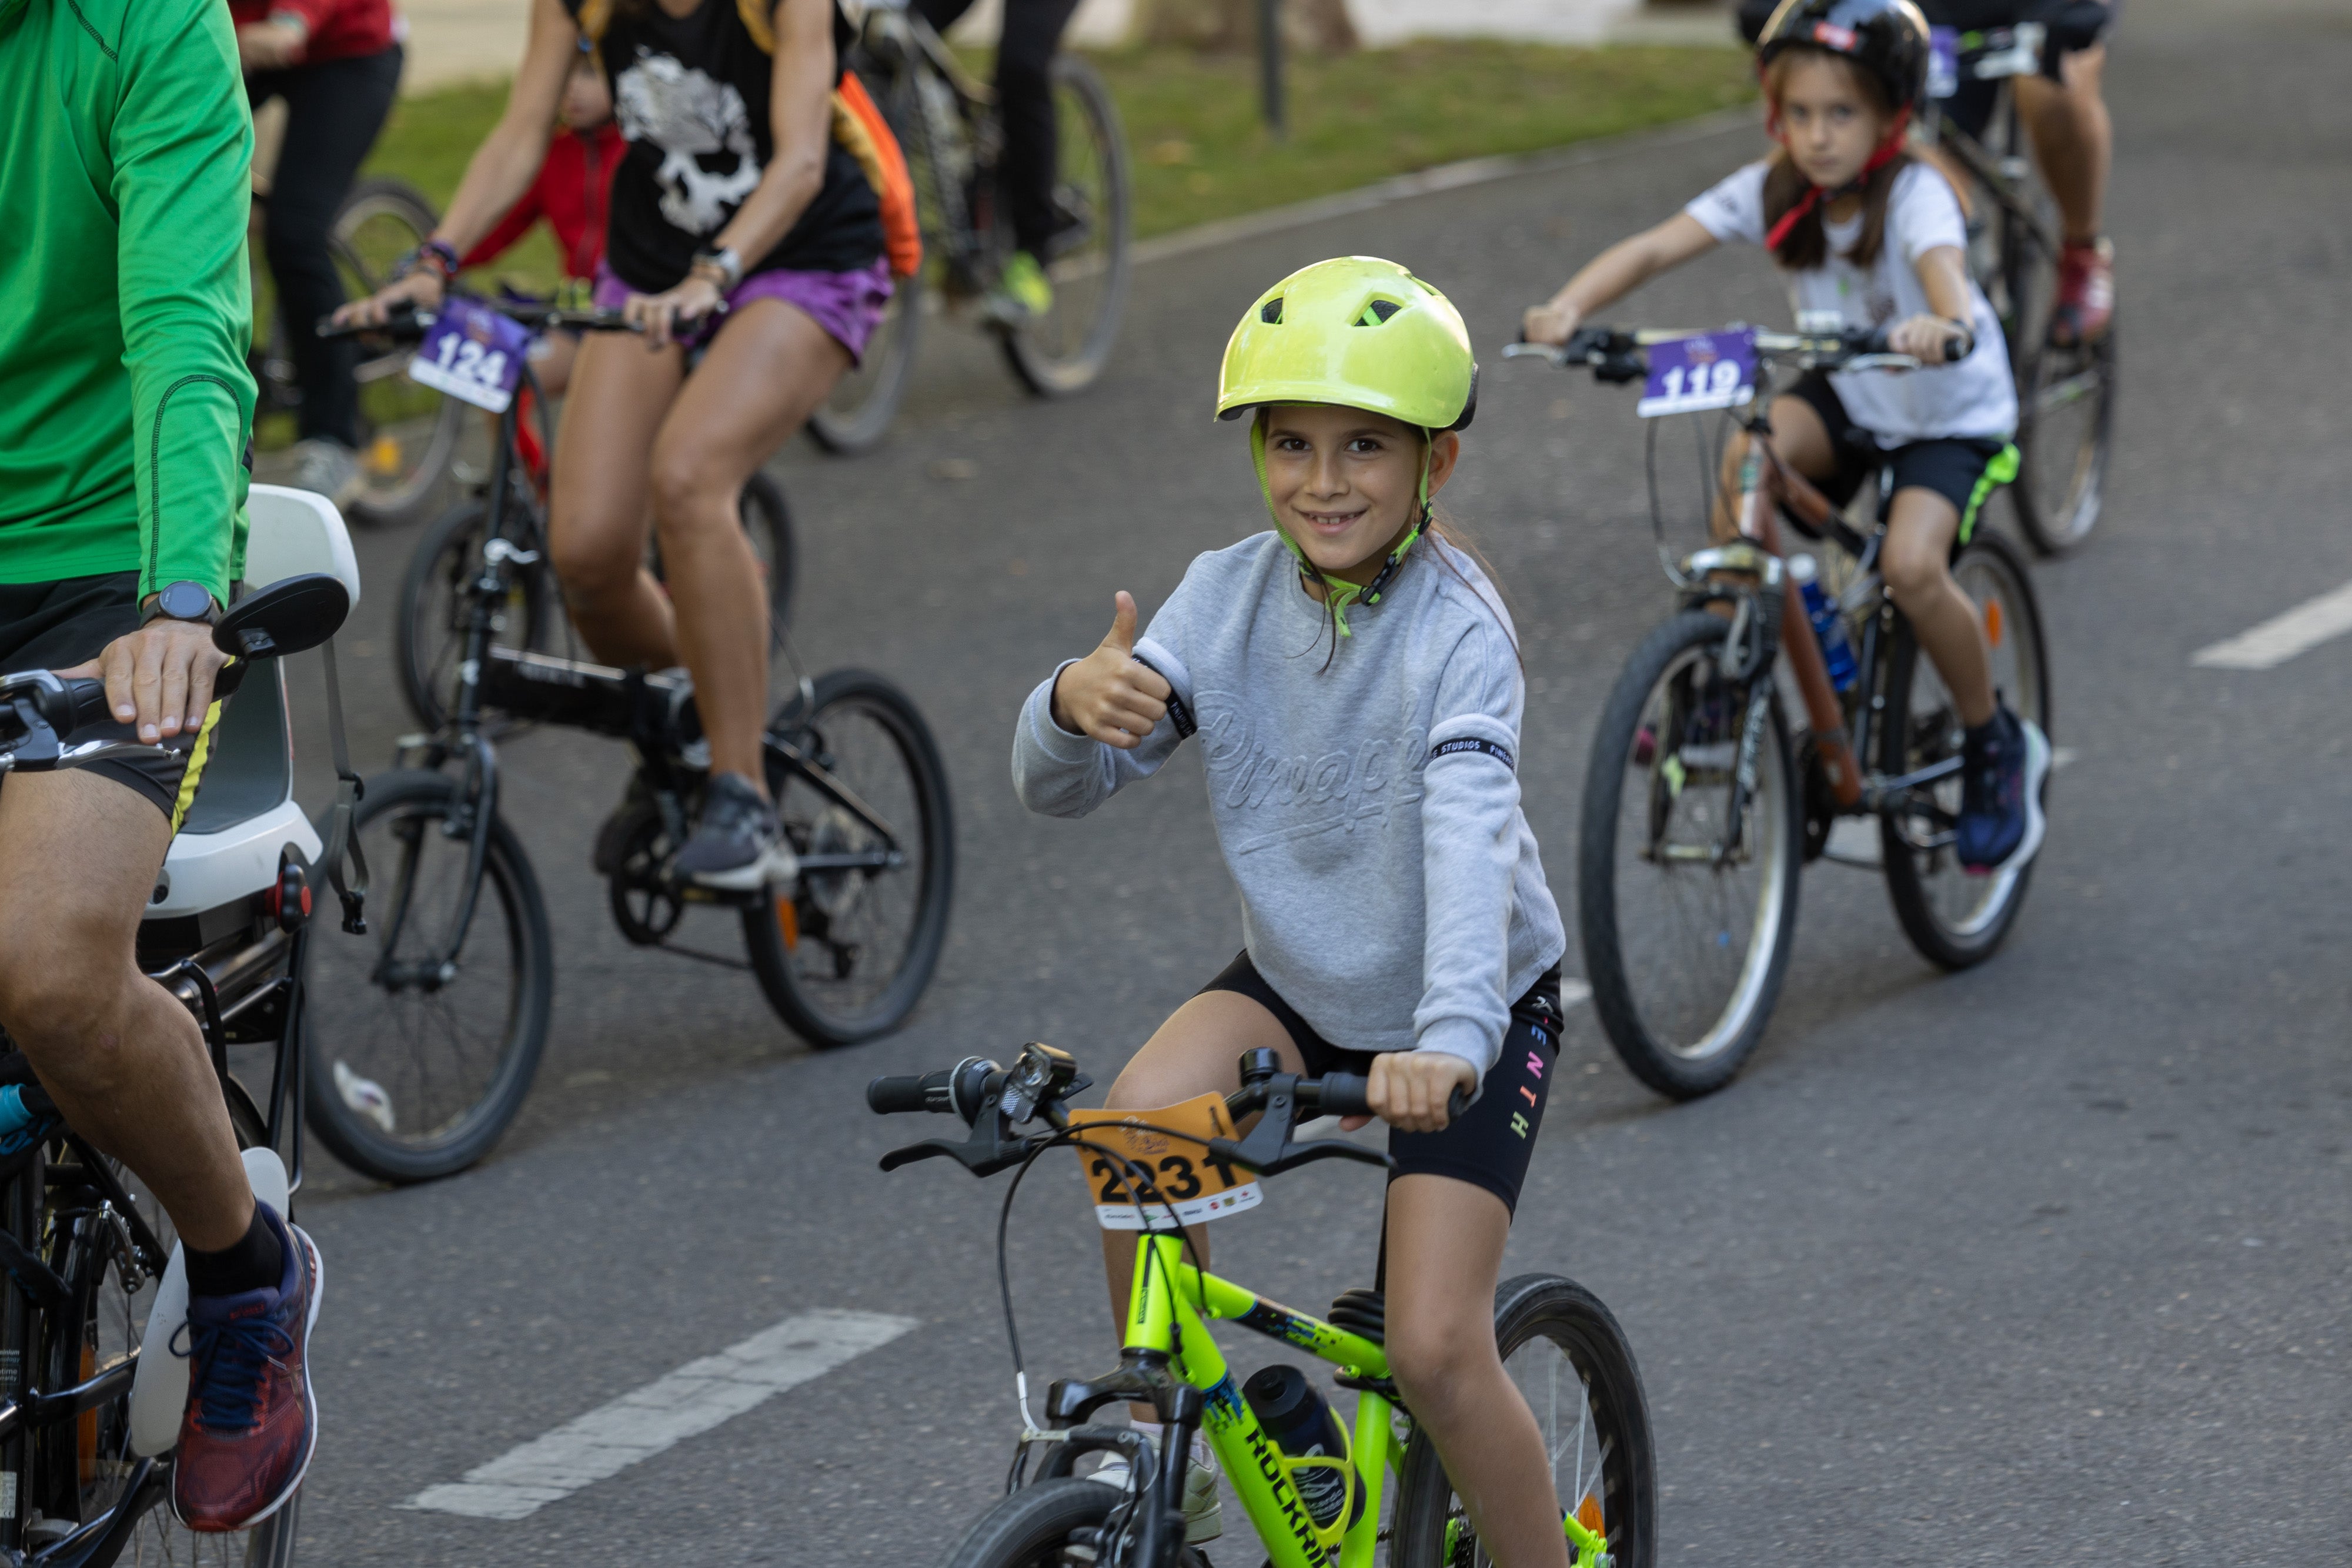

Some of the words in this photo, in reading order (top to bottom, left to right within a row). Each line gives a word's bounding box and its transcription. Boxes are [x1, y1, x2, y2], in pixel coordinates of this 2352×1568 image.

[437, 332, 507, 388] 124
[1661, 359, 1742, 400] 119
[1441, 741, 1481, 754] STUDIOS
[1489, 745, 1515, 770] PINEA
[1509, 1017, 1549, 1139] ENTH
[1091, 1155, 1238, 1202] 2231
